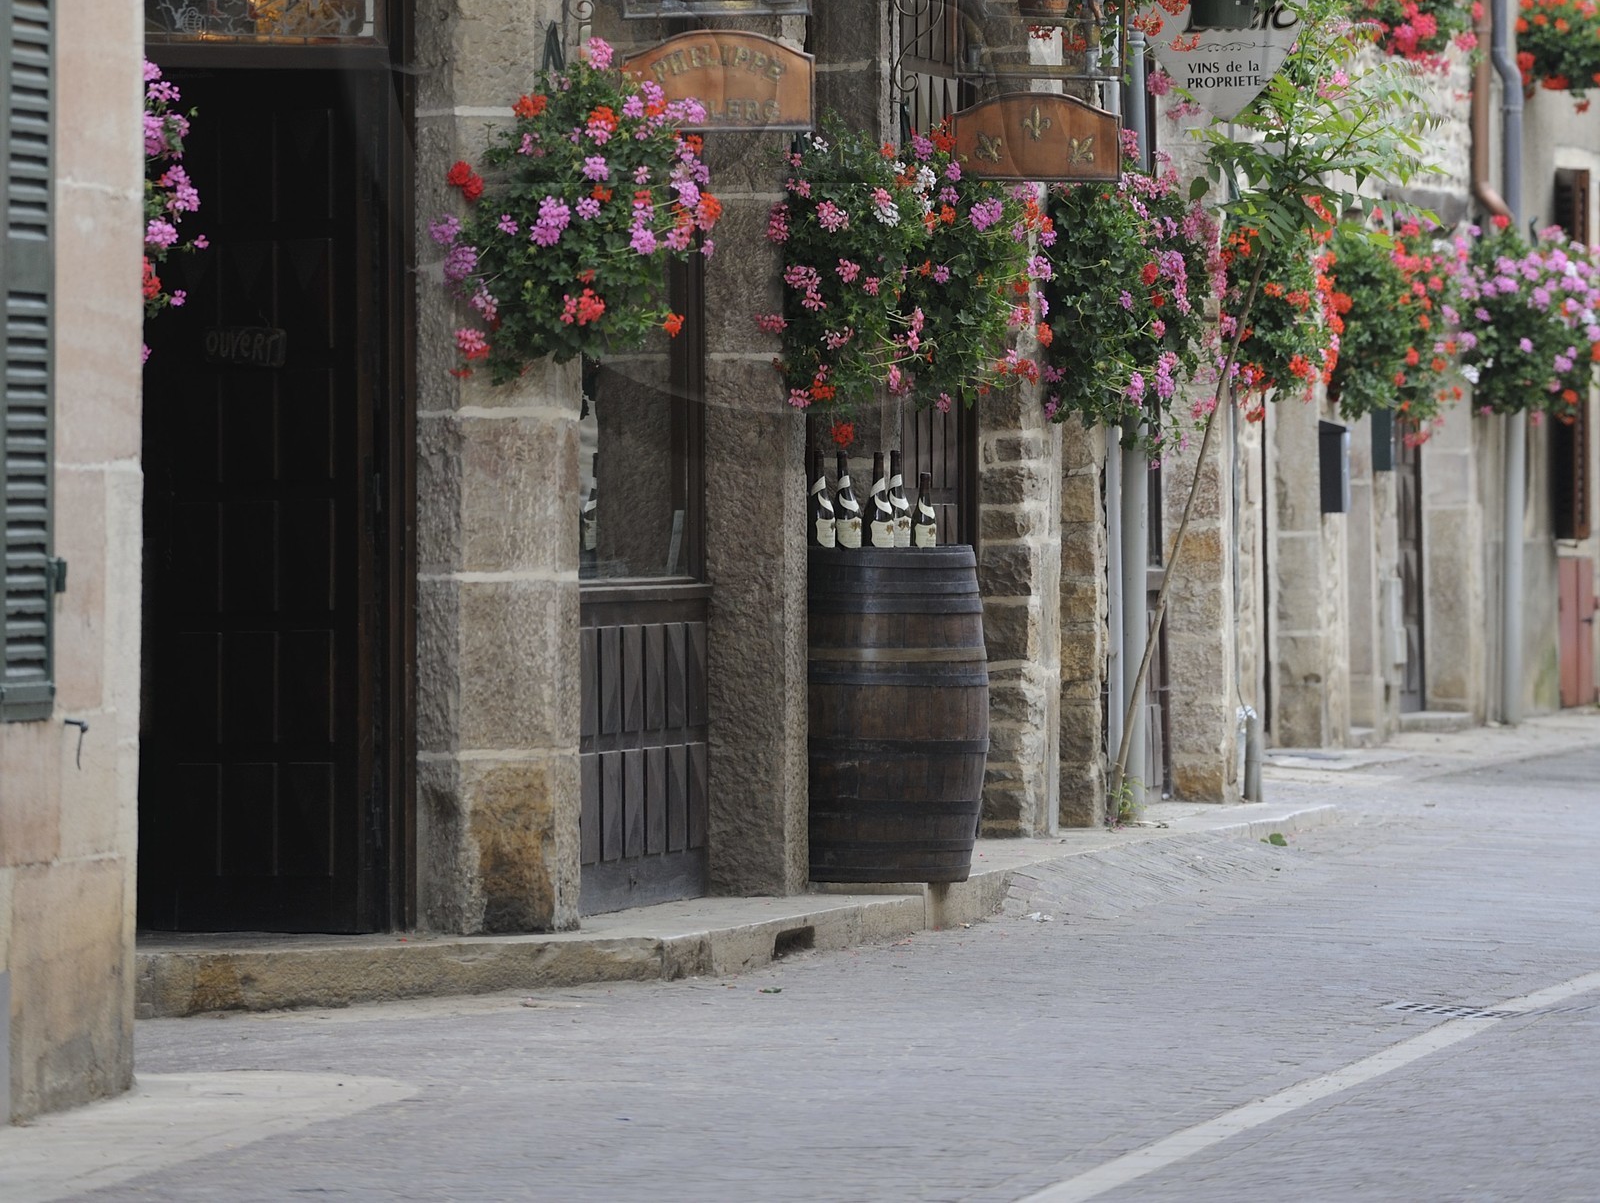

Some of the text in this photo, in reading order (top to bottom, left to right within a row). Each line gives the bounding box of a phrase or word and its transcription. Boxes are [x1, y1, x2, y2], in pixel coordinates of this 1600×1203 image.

[650, 44, 788, 84] PHILIPPE
[1187, 60, 1260, 74] VINS de la
[1187, 75, 1261, 89] PROPRIETE
